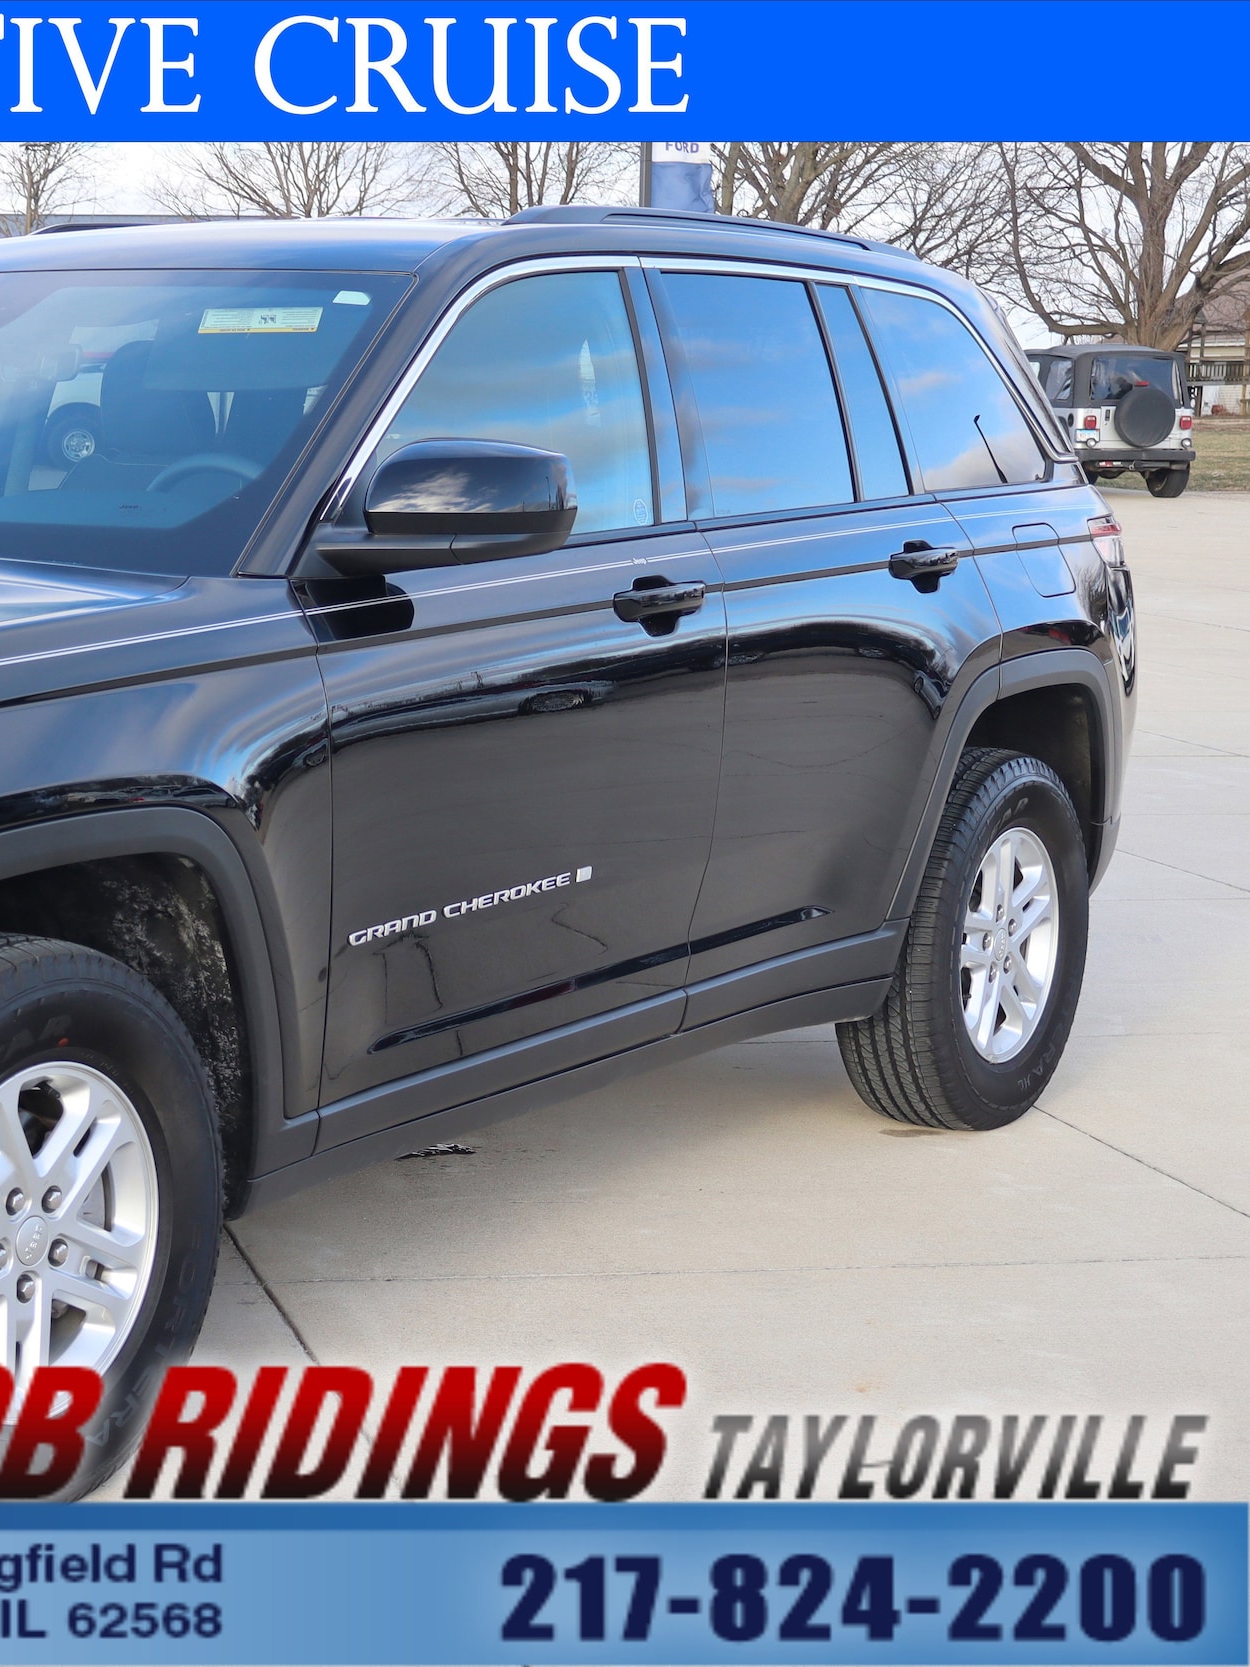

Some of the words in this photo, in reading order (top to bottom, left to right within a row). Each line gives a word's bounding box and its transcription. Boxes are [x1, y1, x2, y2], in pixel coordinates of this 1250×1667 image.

[665, 142, 699, 153] FORD
[347, 909, 438, 947] GRAND
[442, 872, 572, 919] CHEROKEE
